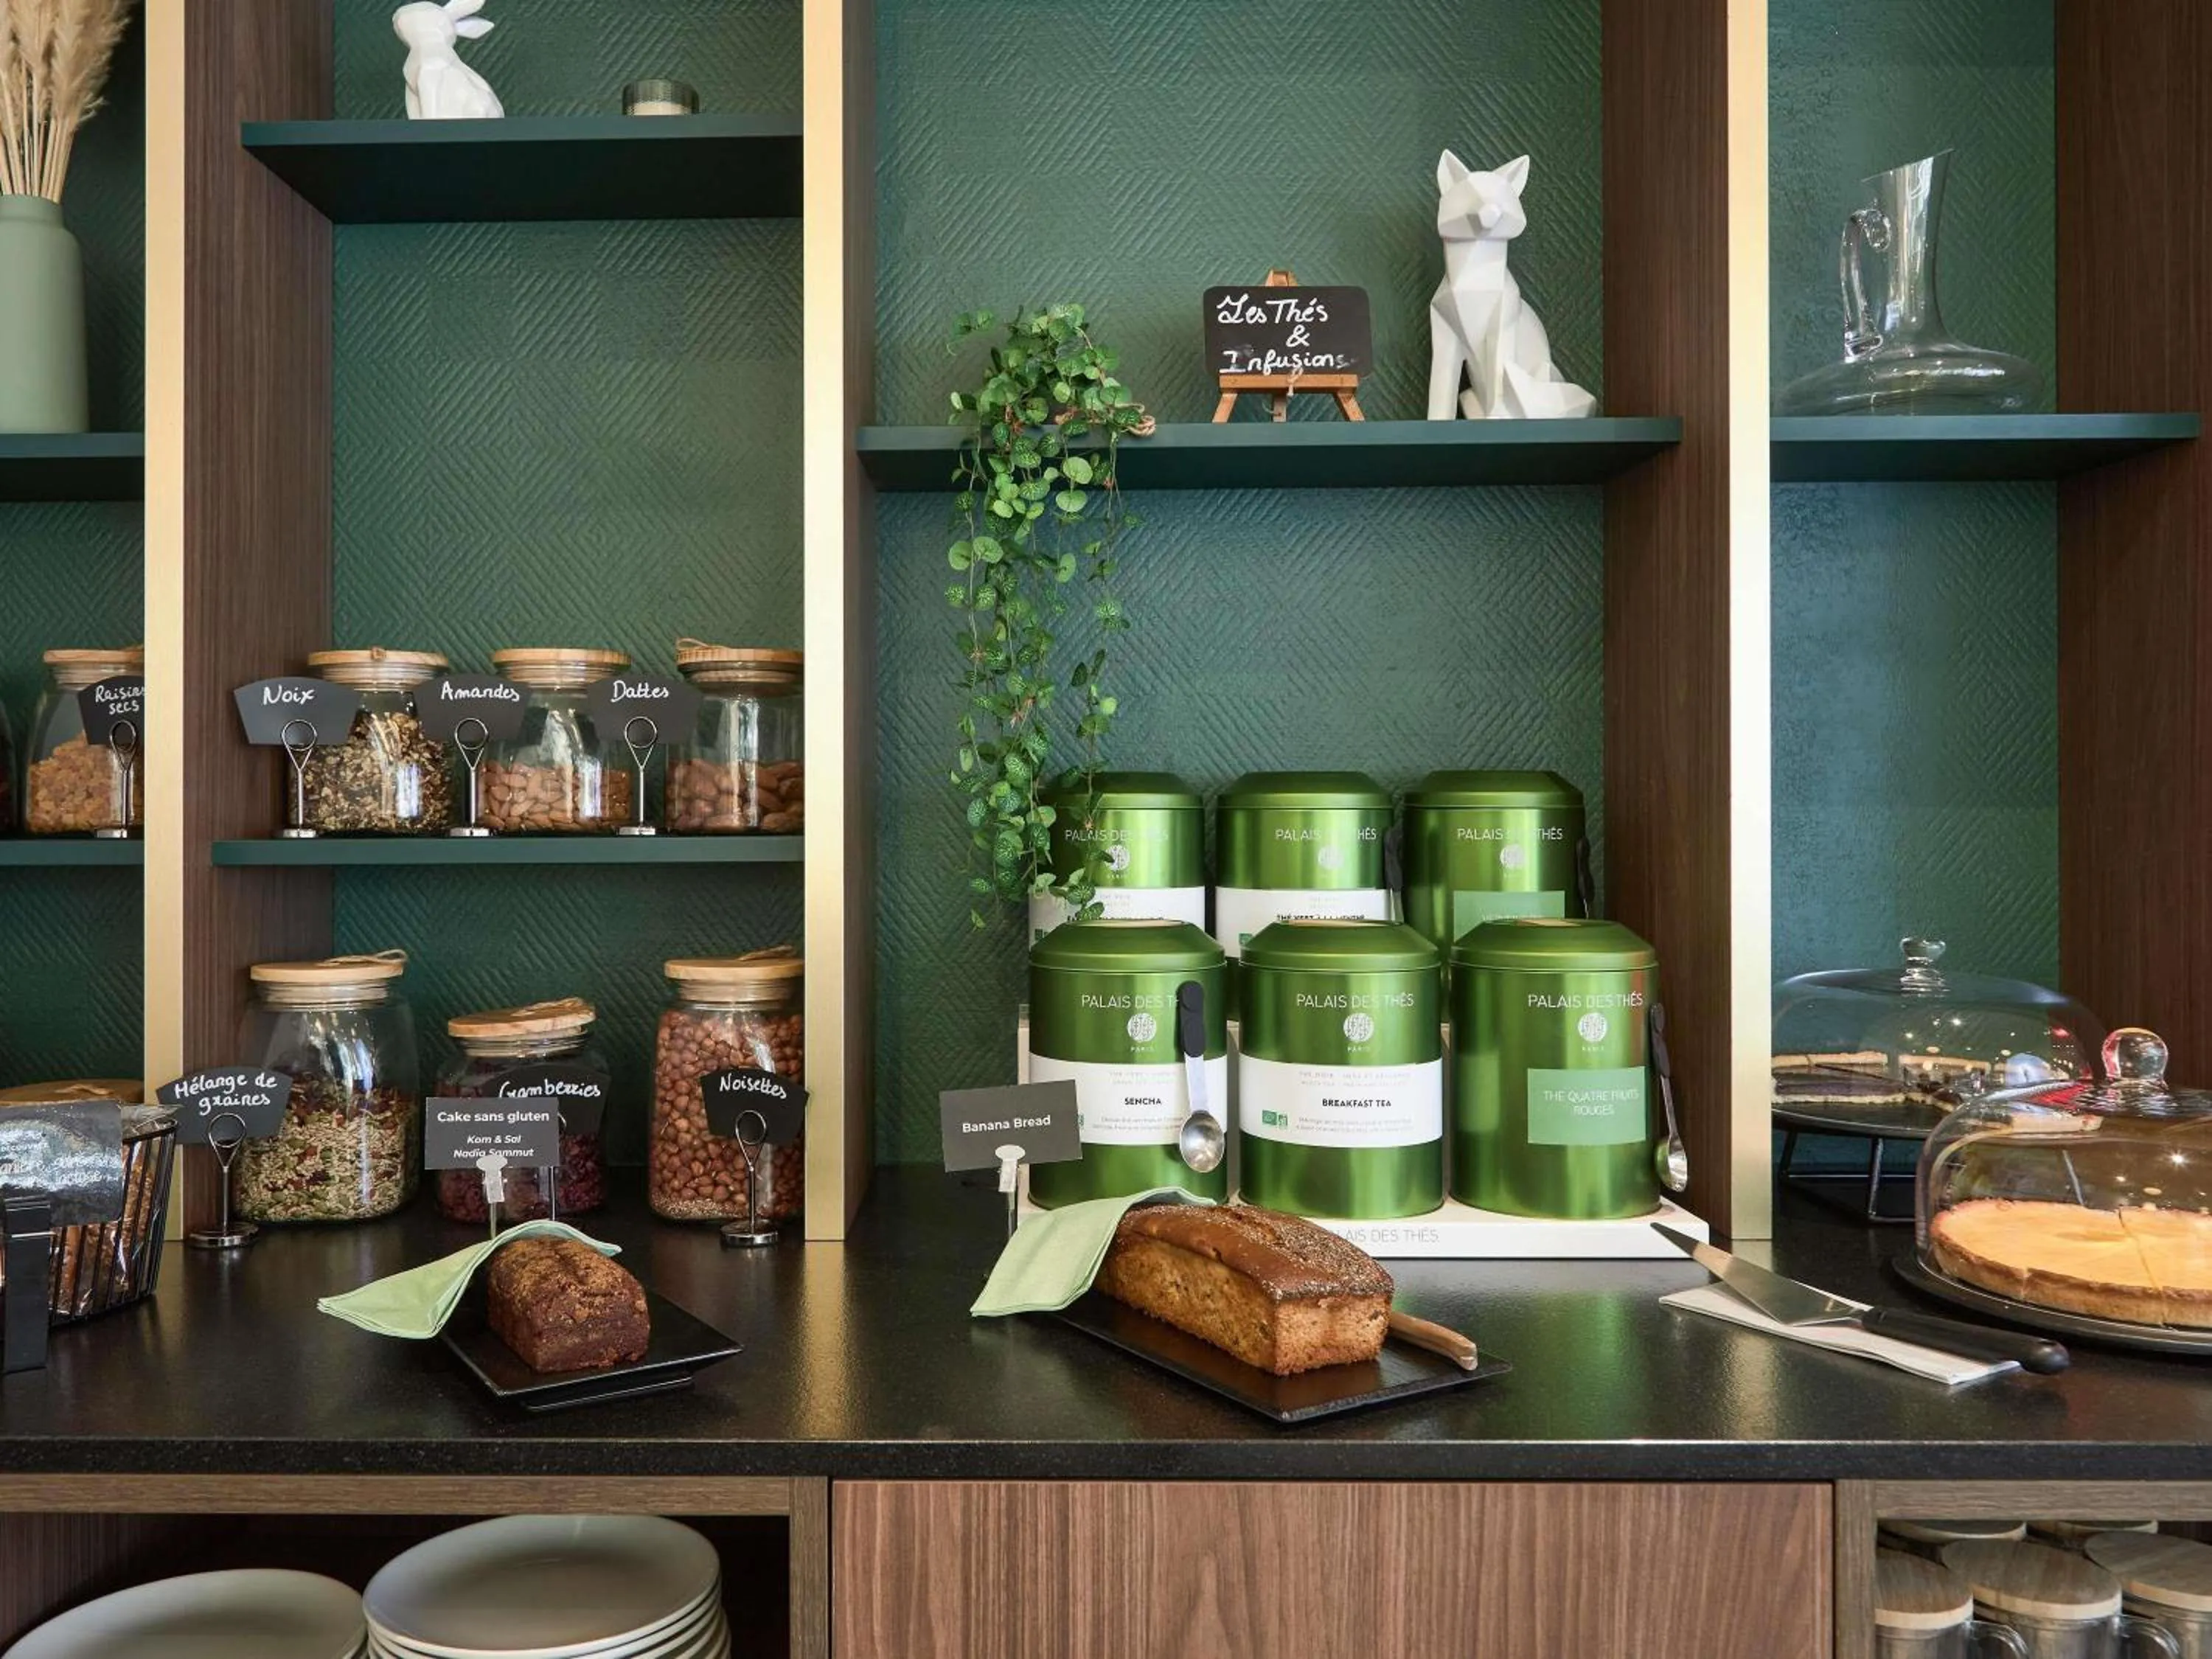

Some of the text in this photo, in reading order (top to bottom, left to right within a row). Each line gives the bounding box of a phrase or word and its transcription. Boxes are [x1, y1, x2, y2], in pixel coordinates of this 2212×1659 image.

[1217, 293, 1328, 324] Les Thés
[1286, 324, 1310, 347] &
[1219, 349, 1350, 375] Infusions
[263, 684, 315, 706] Noix
[441, 681, 520, 702] Amandes
[611, 679, 669, 703] Dattes
[108, 700, 139, 715] secs
[1275, 828, 1322, 841] PALAIS
[1457, 828, 1503, 841] PALAIS
[1081, 994, 1131, 1009] PALAIS
[1134, 995, 1164, 1009] DES
[1297, 991, 1415, 1009] PALAIS DES THÉS
[1528, 990, 1644, 1009] PALAIS DES THÉS
[174, 1072, 277, 1099] Mélange de
[719, 1072, 787, 1099] Noisettes
[198, 1093, 271, 1116] graines
[1124, 1096, 1162, 1105] SENCHA
[1322, 1099, 1373, 1107] BREAKFAST
[437, 1110, 550, 1126] Cake sans gluten
[962, 1114, 1051, 1133] Banana Bread
[494, 1135, 502, 1144] &
[453, 1148, 535, 1158] Nadia Sammut
[1370, 1228, 1399, 1242] DES
